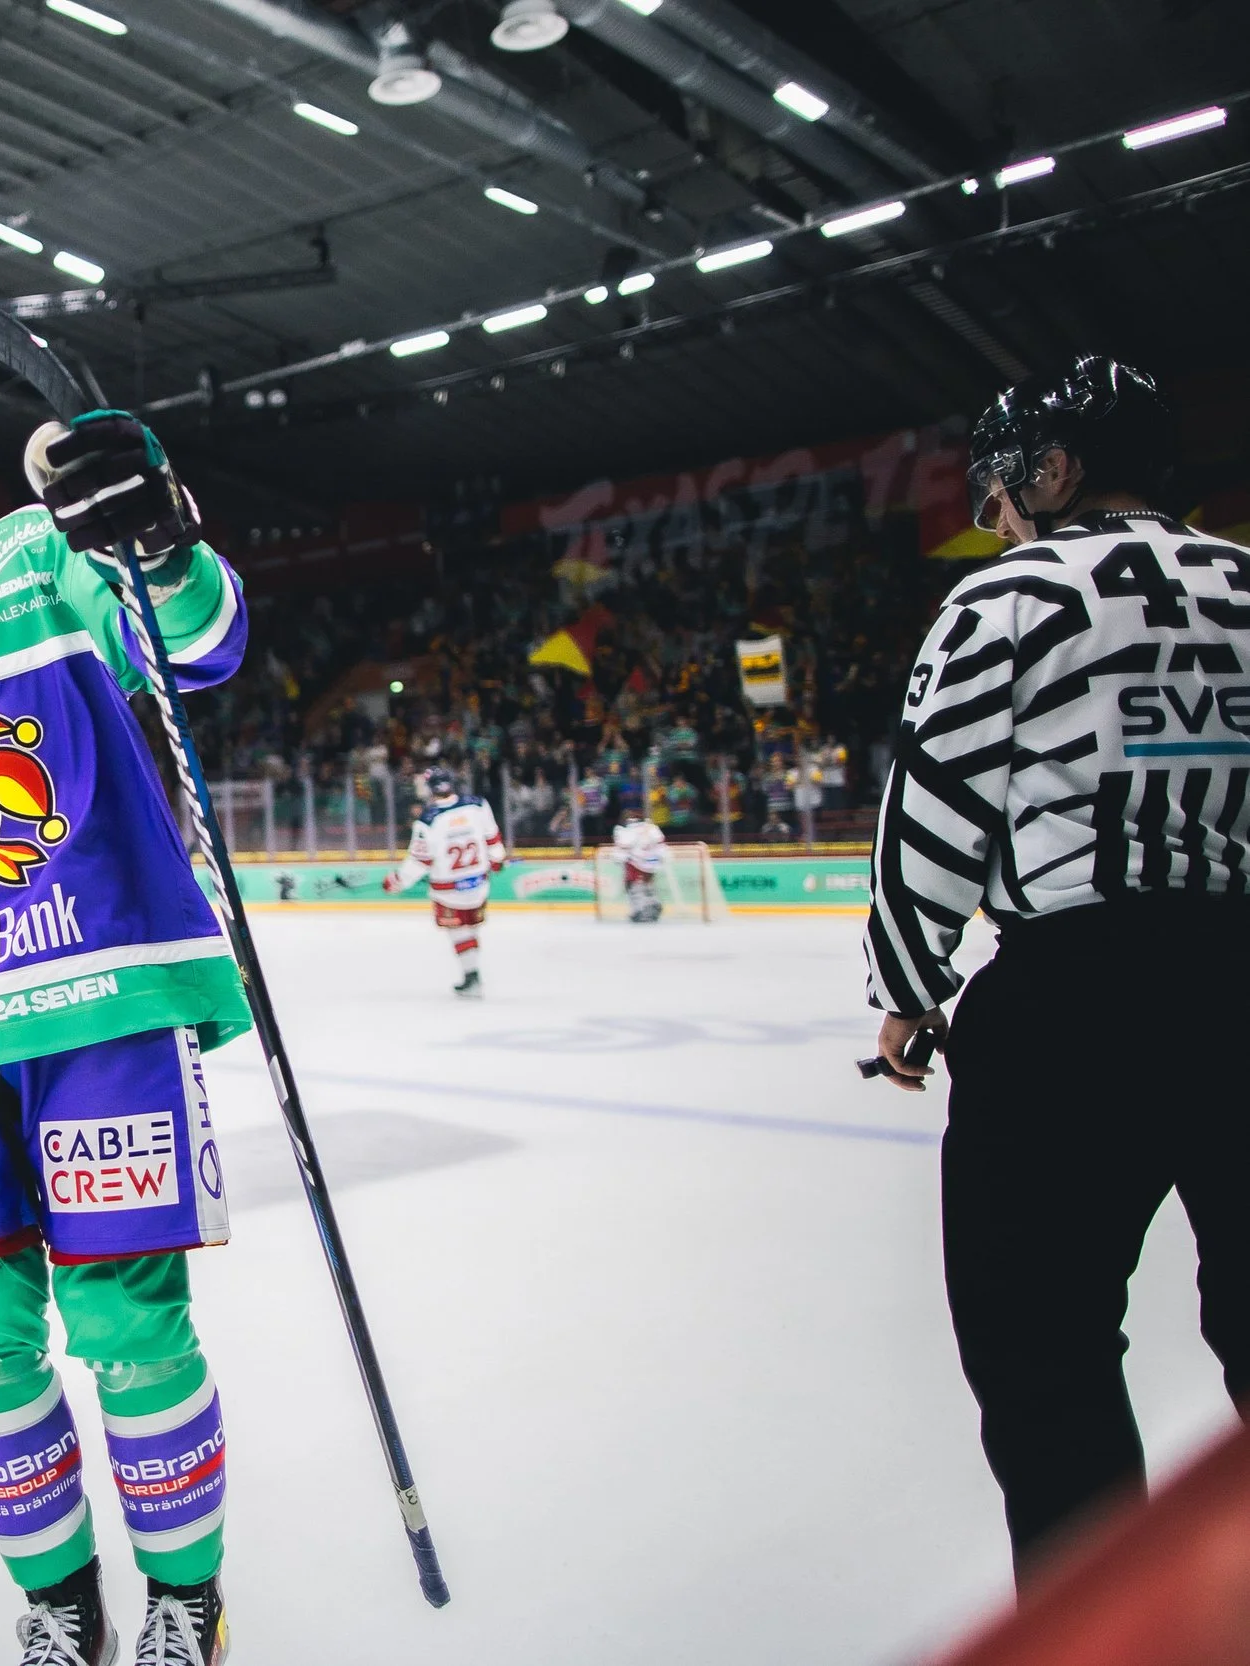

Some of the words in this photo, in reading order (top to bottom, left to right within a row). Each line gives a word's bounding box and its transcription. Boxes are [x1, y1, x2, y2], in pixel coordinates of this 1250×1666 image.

[1090, 541, 1250, 630] 43
[907, 663, 934, 708] 3
[447, 842, 480, 871] 22
[43, 1120, 173, 1164] CABLE
[51, 1162, 168, 1205] CREW
[123, 1475, 190, 1496] GROUP
[141, 1471, 224, 1513] Brändillesi
